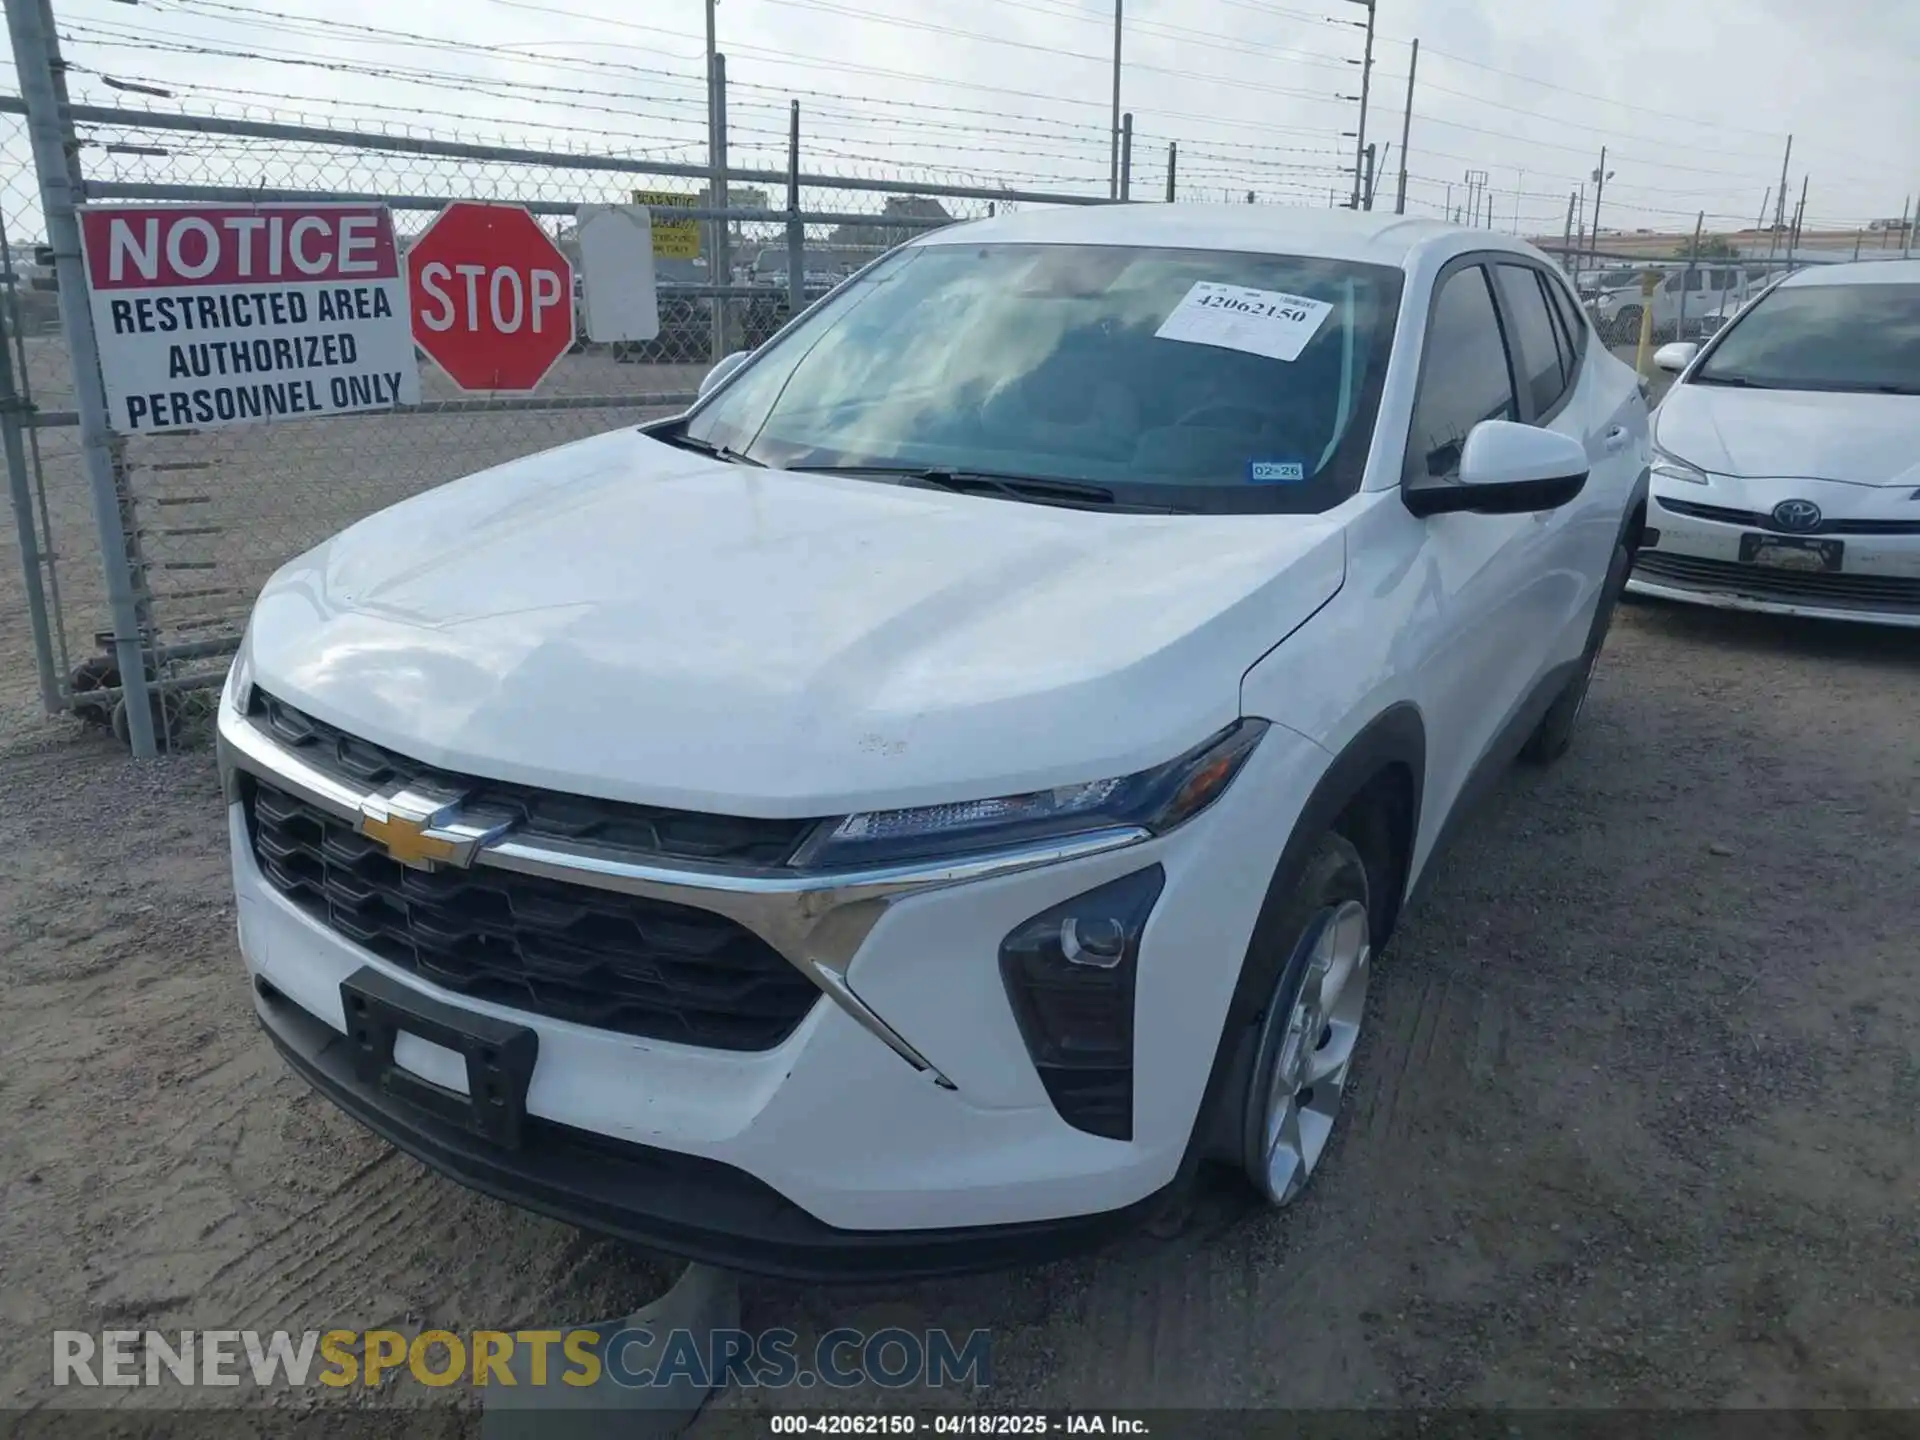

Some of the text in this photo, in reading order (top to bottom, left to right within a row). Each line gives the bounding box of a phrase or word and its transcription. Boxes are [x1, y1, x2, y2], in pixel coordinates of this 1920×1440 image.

[108, 215, 379, 281] NOTICE
[112, 286, 393, 334] RESTRICTED AREA
[420, 262, 562, 334] STOP
[1197, 295, 1307, 322] 42062150
[169, 333, 358, 379] AUTHORIZED
[126, 372, 403, 429] PERSONNEL ONLY
